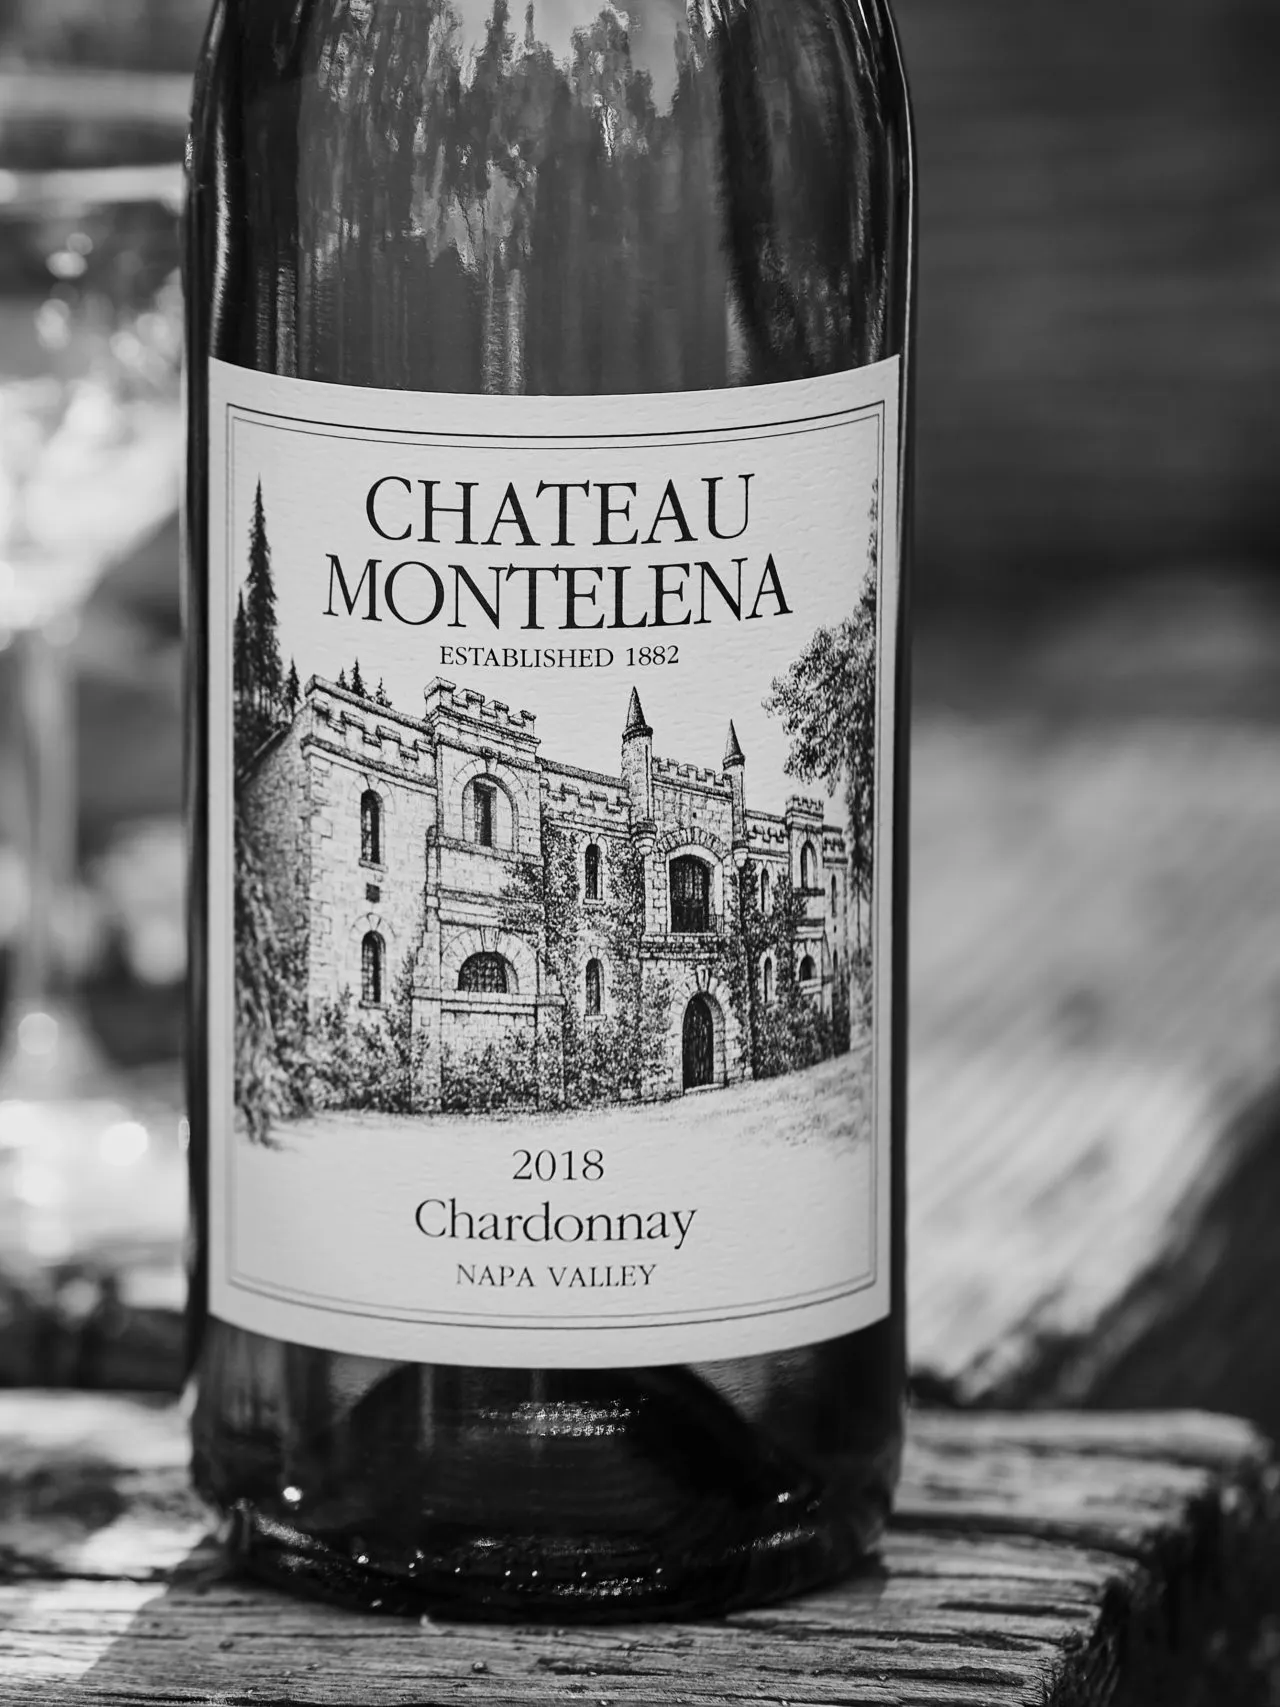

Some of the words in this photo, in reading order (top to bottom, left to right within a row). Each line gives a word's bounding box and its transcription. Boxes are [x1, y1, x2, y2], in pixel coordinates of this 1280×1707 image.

[366, 473, 755, 546] CHATEAU
[322, 553, 793, 630] MONTELENA
[439, 645, 614, 668] ESTABLISHED
[626, 644, 680, 667] 1882
[512, 1149, 605, 1182] 2018
[415, 1197, 698, 1250] Chardonnay
[456, 1263, 536, 1288] NAPA
[547, 1263, 657, 1288] VALLEY
